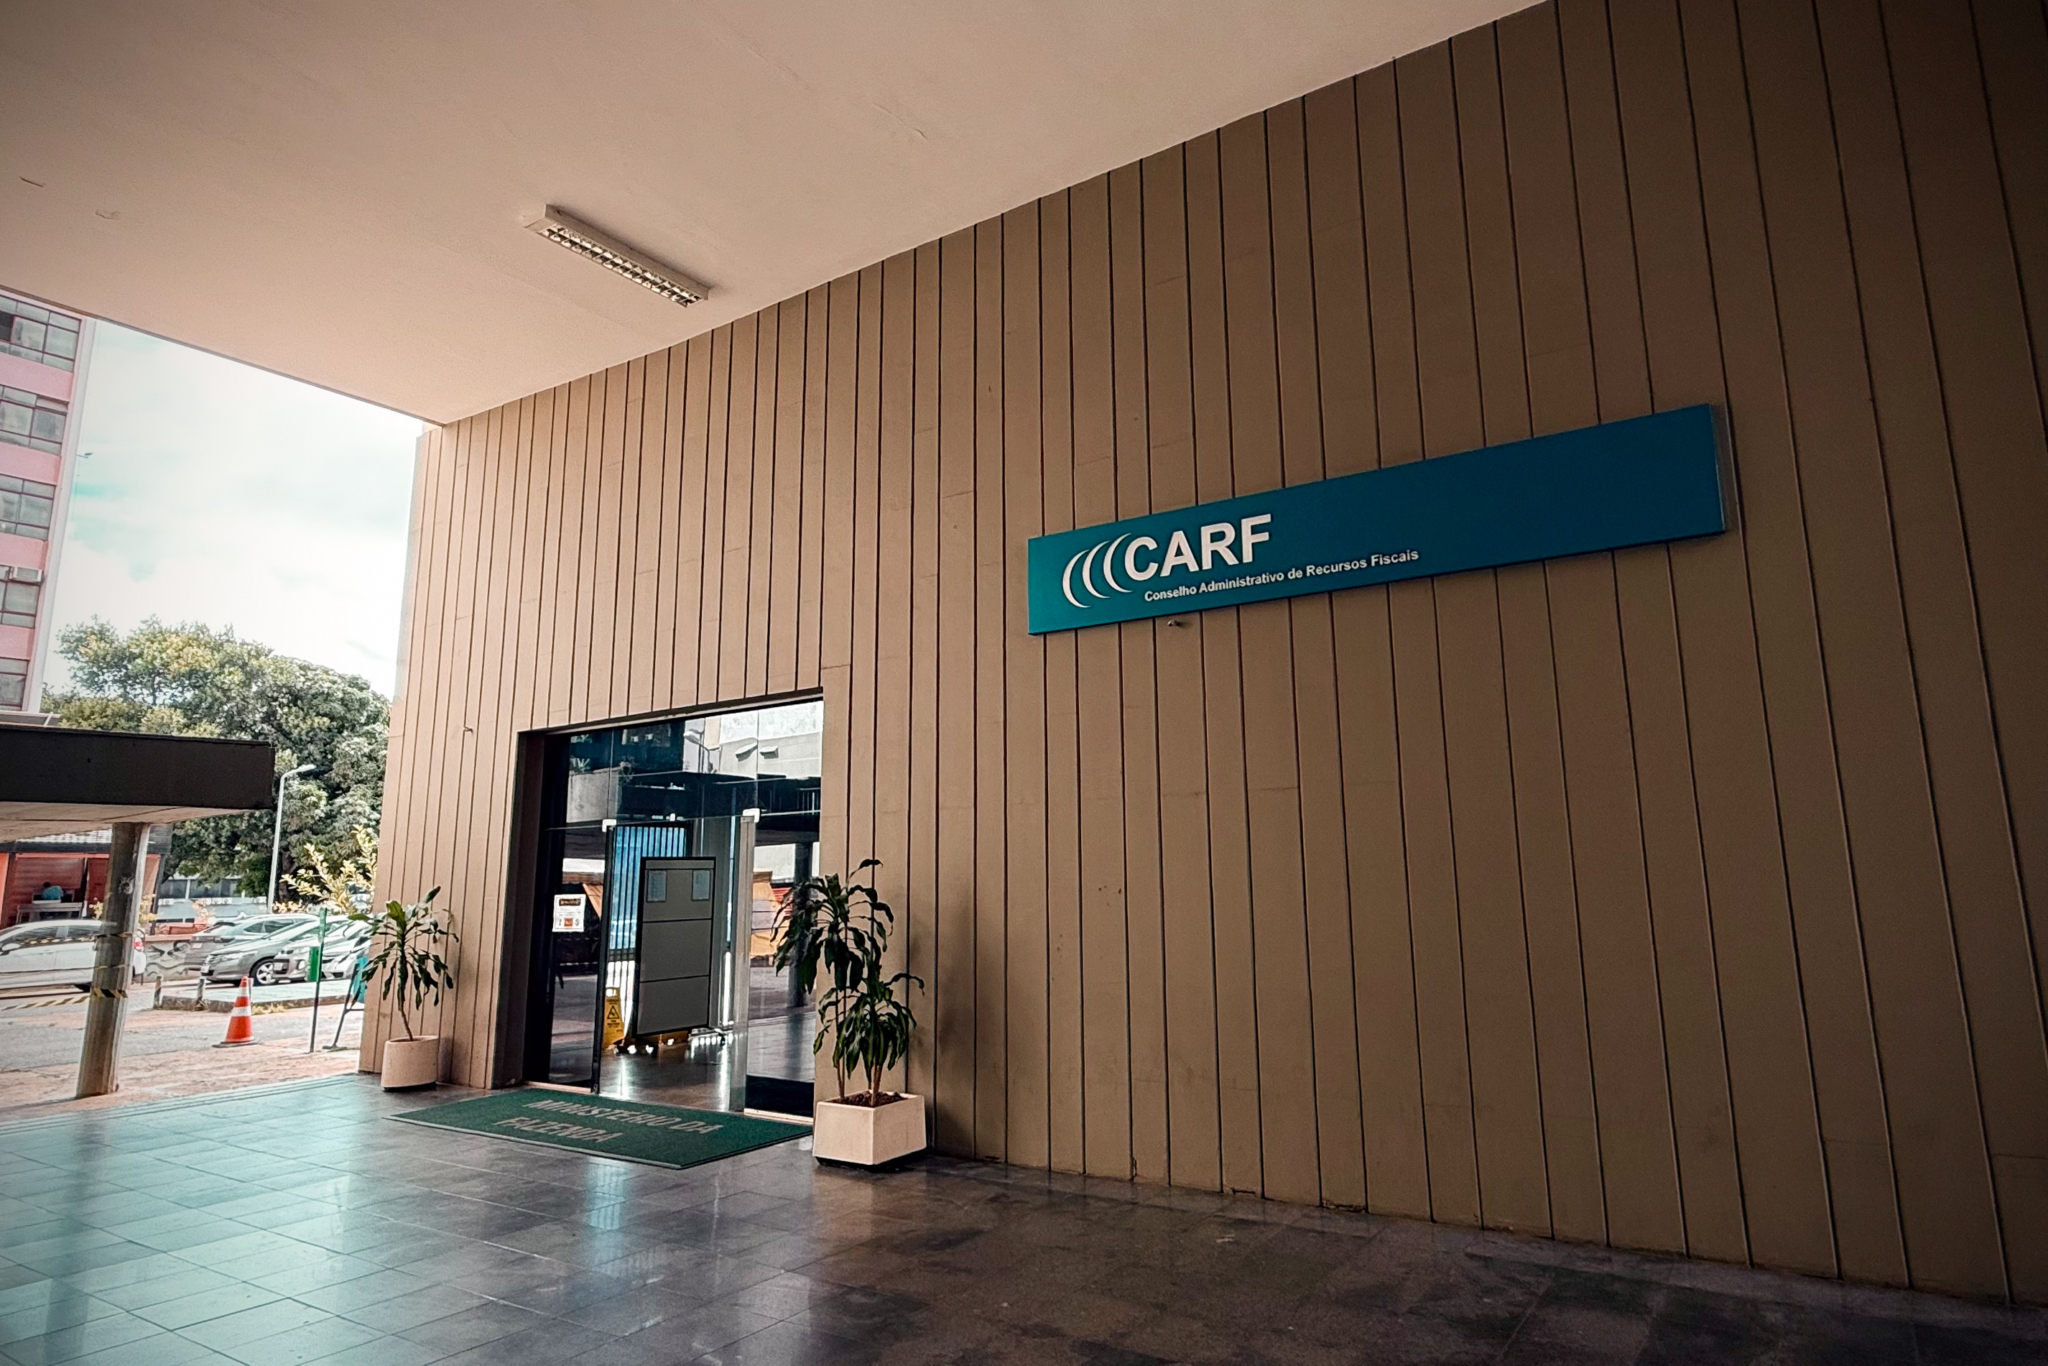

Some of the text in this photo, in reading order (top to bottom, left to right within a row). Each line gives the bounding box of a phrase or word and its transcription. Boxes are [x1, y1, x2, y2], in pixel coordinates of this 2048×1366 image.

[1124, 513, 1272, 581] CARF
[1144, 549, 1419, 602] Conselho Administrativo de Recursos Fiscais
[493, 1116, 625, 1143] FAZENDA
[668, 1120, 723, 1135] DA
